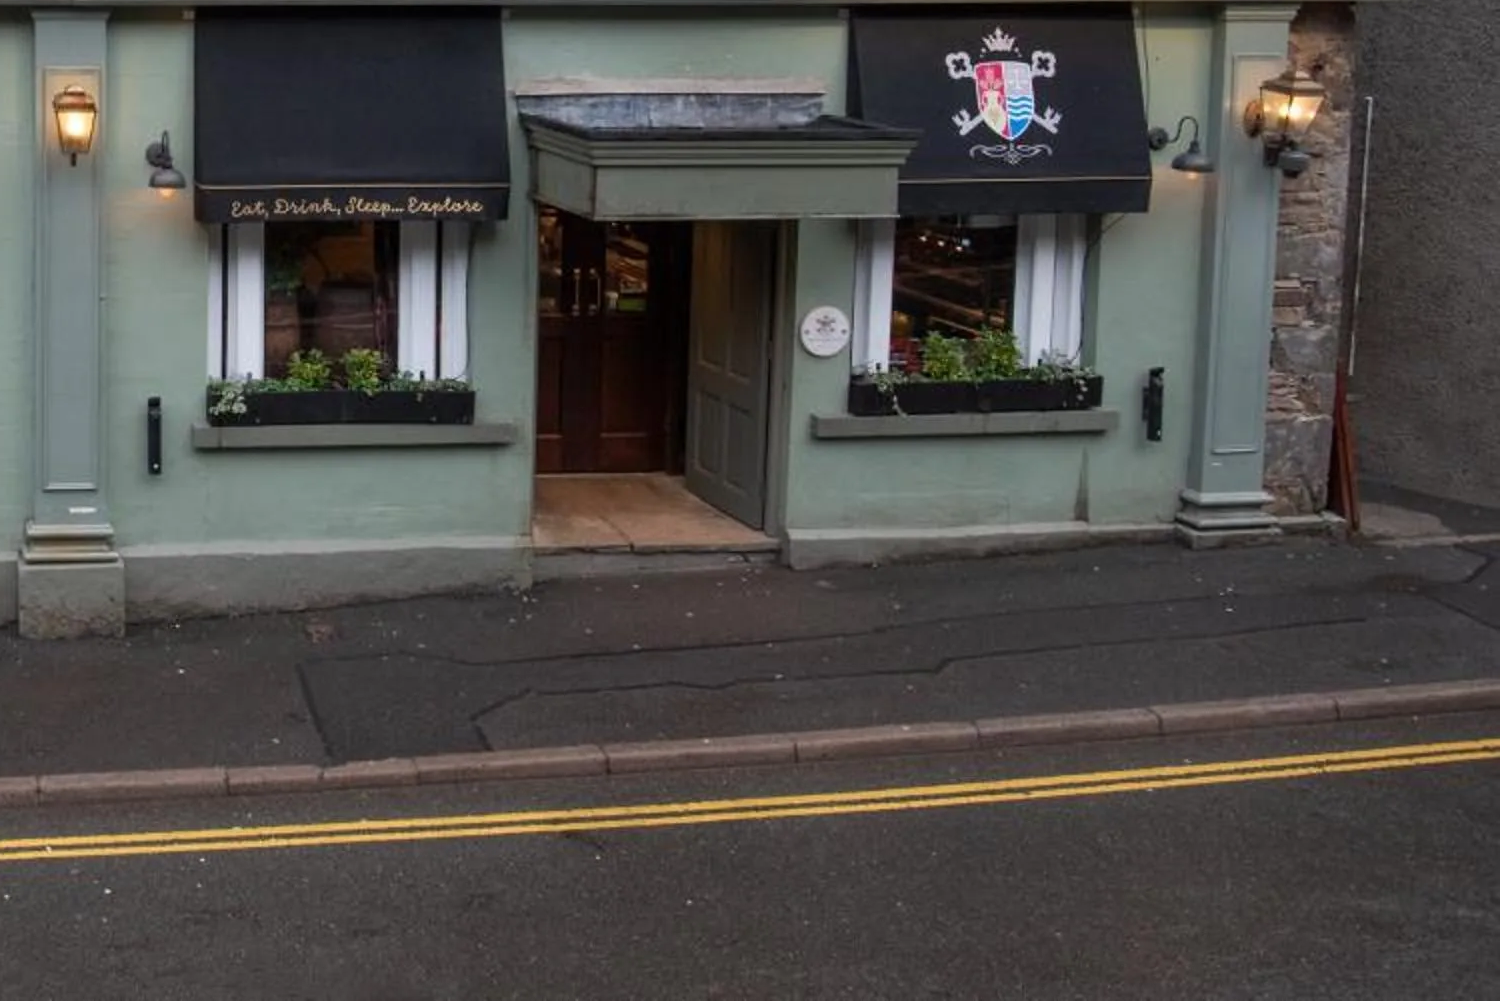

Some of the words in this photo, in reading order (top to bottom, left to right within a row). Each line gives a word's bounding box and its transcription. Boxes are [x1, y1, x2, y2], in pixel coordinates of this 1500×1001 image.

[231, 200, 270, 219] Eat,
[273, 198, 342, 216] Drink,
[345, 196, 404, 217] Sleep...
[407, 196, 484, 217] Explore
